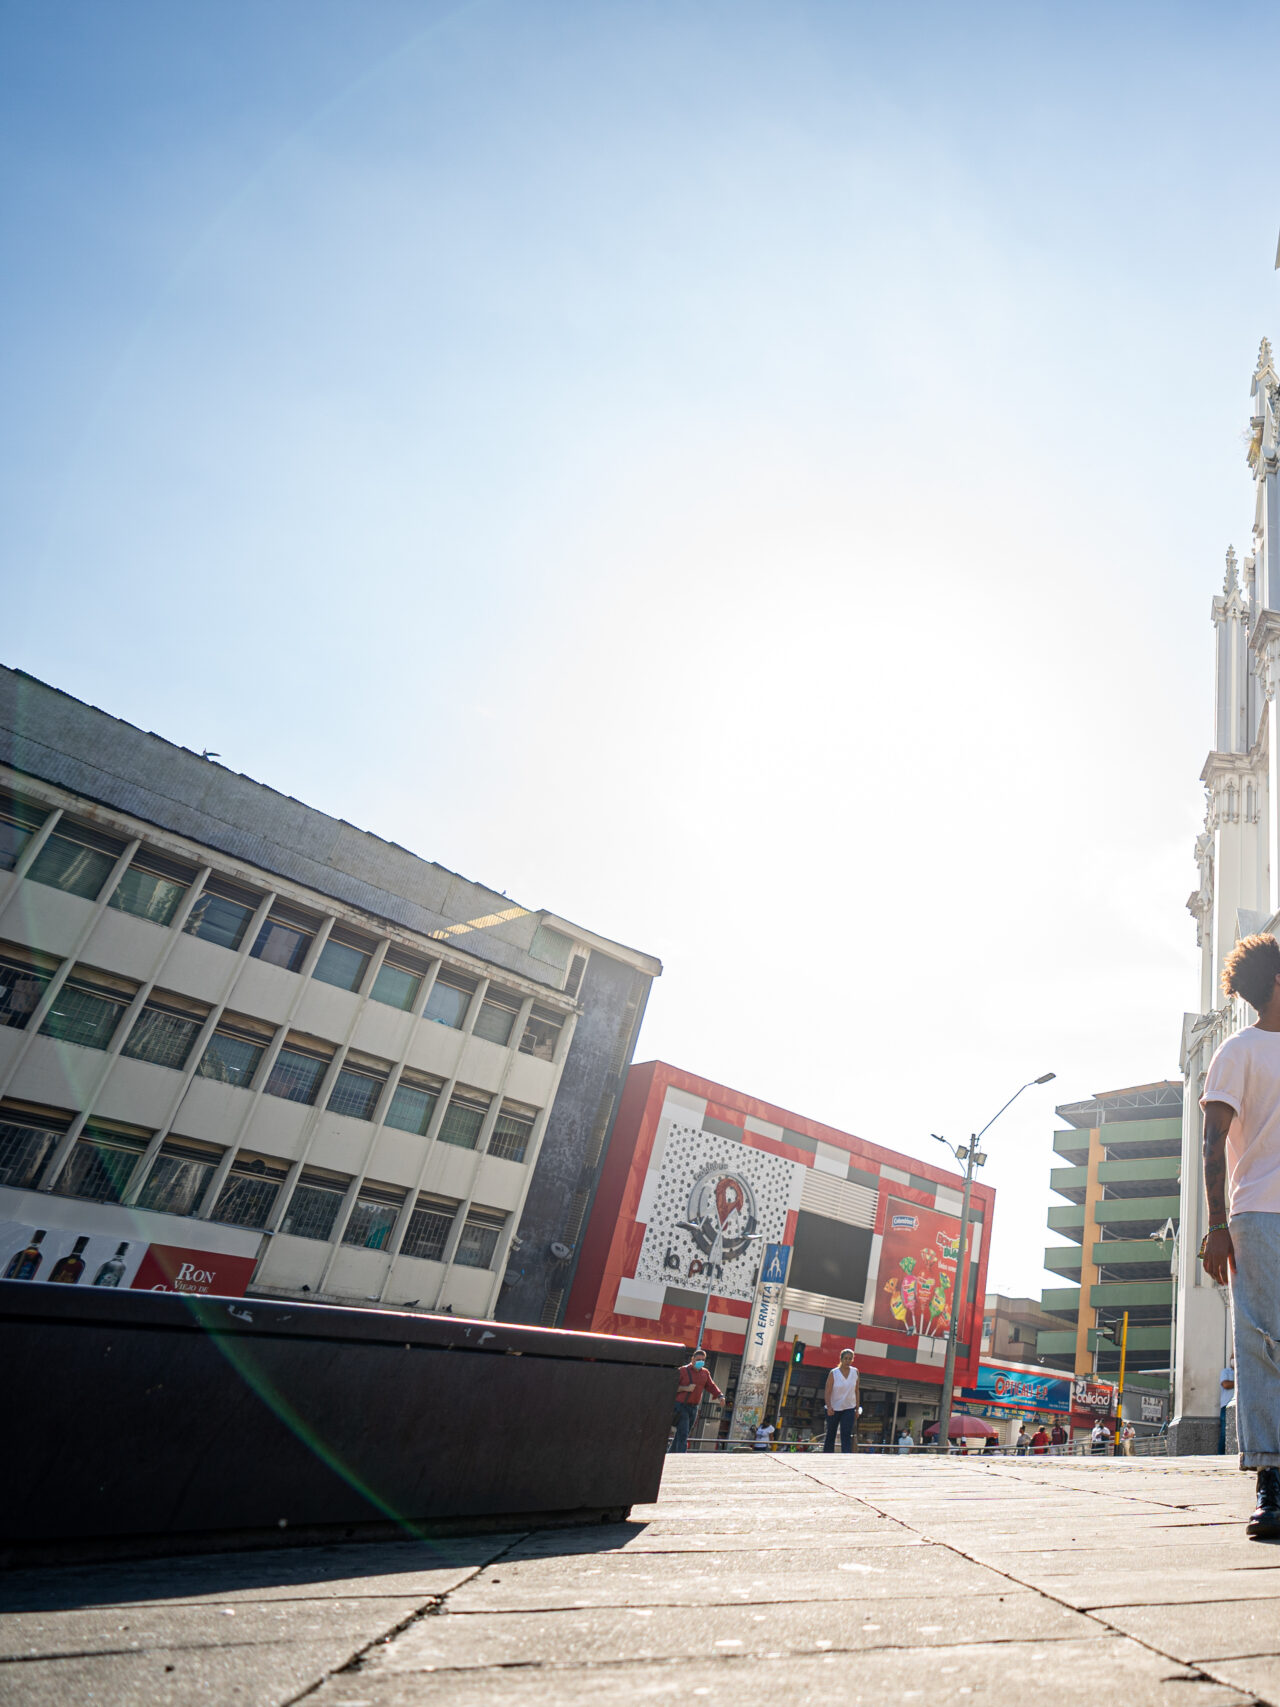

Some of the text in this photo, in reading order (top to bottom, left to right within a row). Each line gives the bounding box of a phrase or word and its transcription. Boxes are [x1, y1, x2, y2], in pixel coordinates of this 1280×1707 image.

[176, 1262, 216, 1284] RON
[754, 1285, 772, 1346] LA ERMITA
